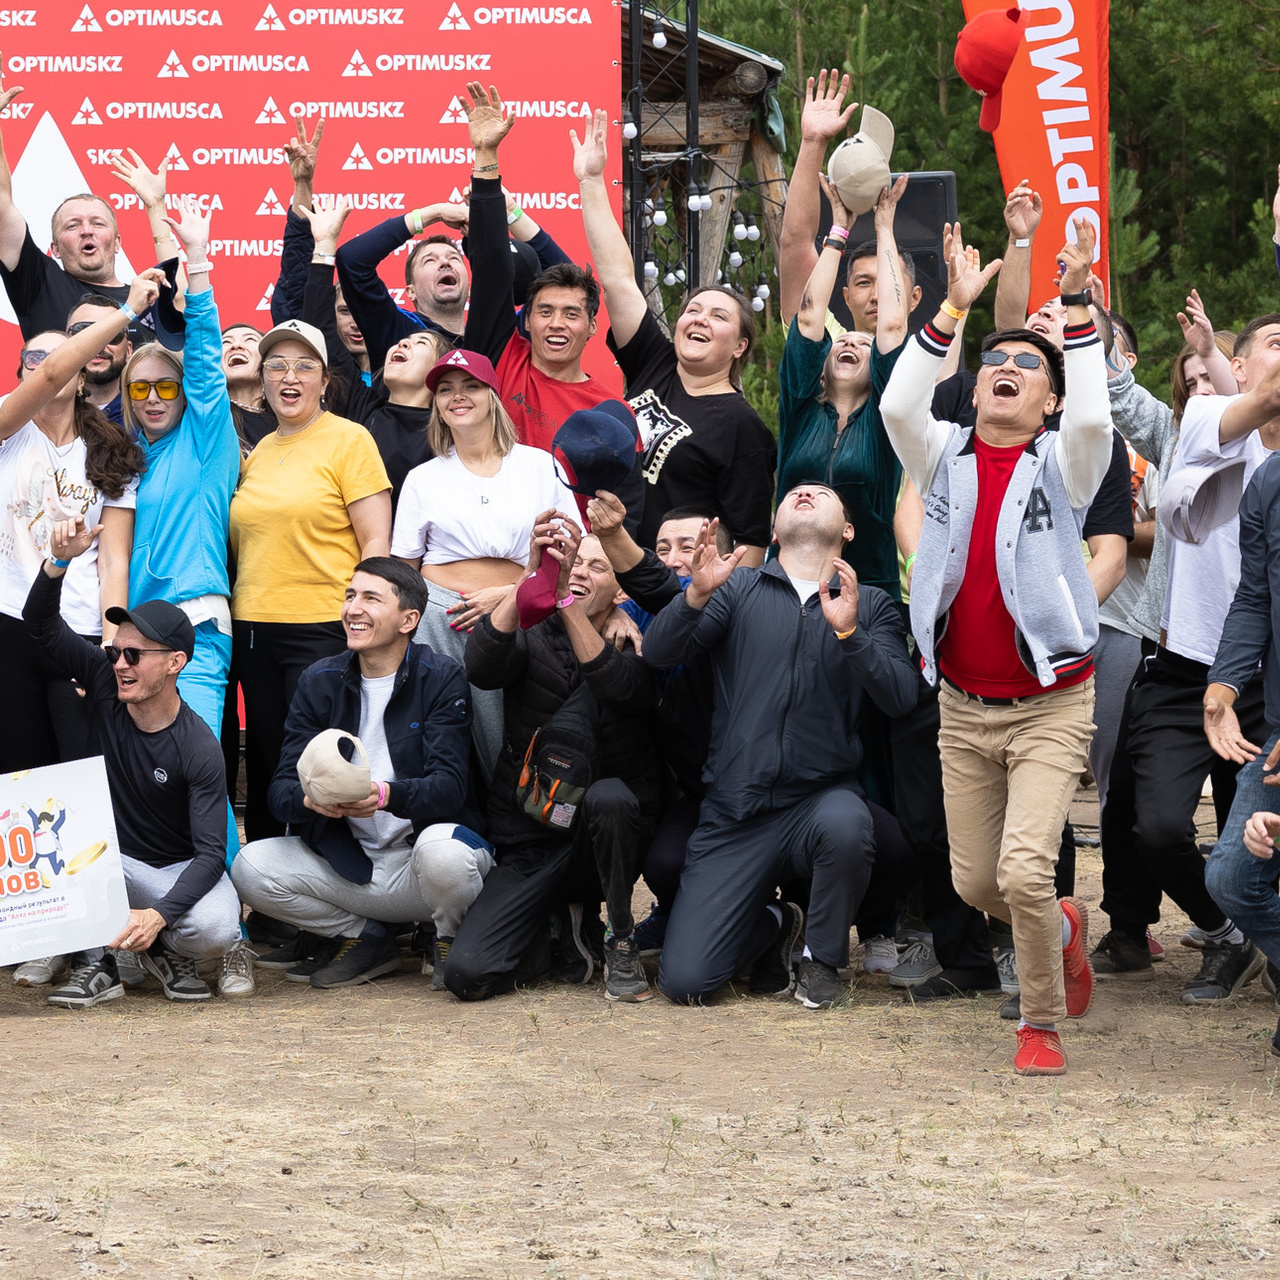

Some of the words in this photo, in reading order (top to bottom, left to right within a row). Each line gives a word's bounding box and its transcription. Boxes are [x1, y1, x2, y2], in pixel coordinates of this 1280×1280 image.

[105, 8, 223, 27] OPTIMUSCA
[288, 7, 405, 26] OPTIMUSKZ
[473, 6, 593, 25] OPTIMUSCA
[7, 55, 123, 73] OPTIMUSKZ
[191, 54, 310, 73] OPTIMUSCA
[375, 53, 492, 72] OPTIMUSKZ
[105, 101, 224, 120] OPTIMUSCA
[288, 101, 405, 120] OPTIMUSKZ
[192, 147, 291, 166] OPTIMUS
[375, 147, 478, 165] OPTIMUSK
